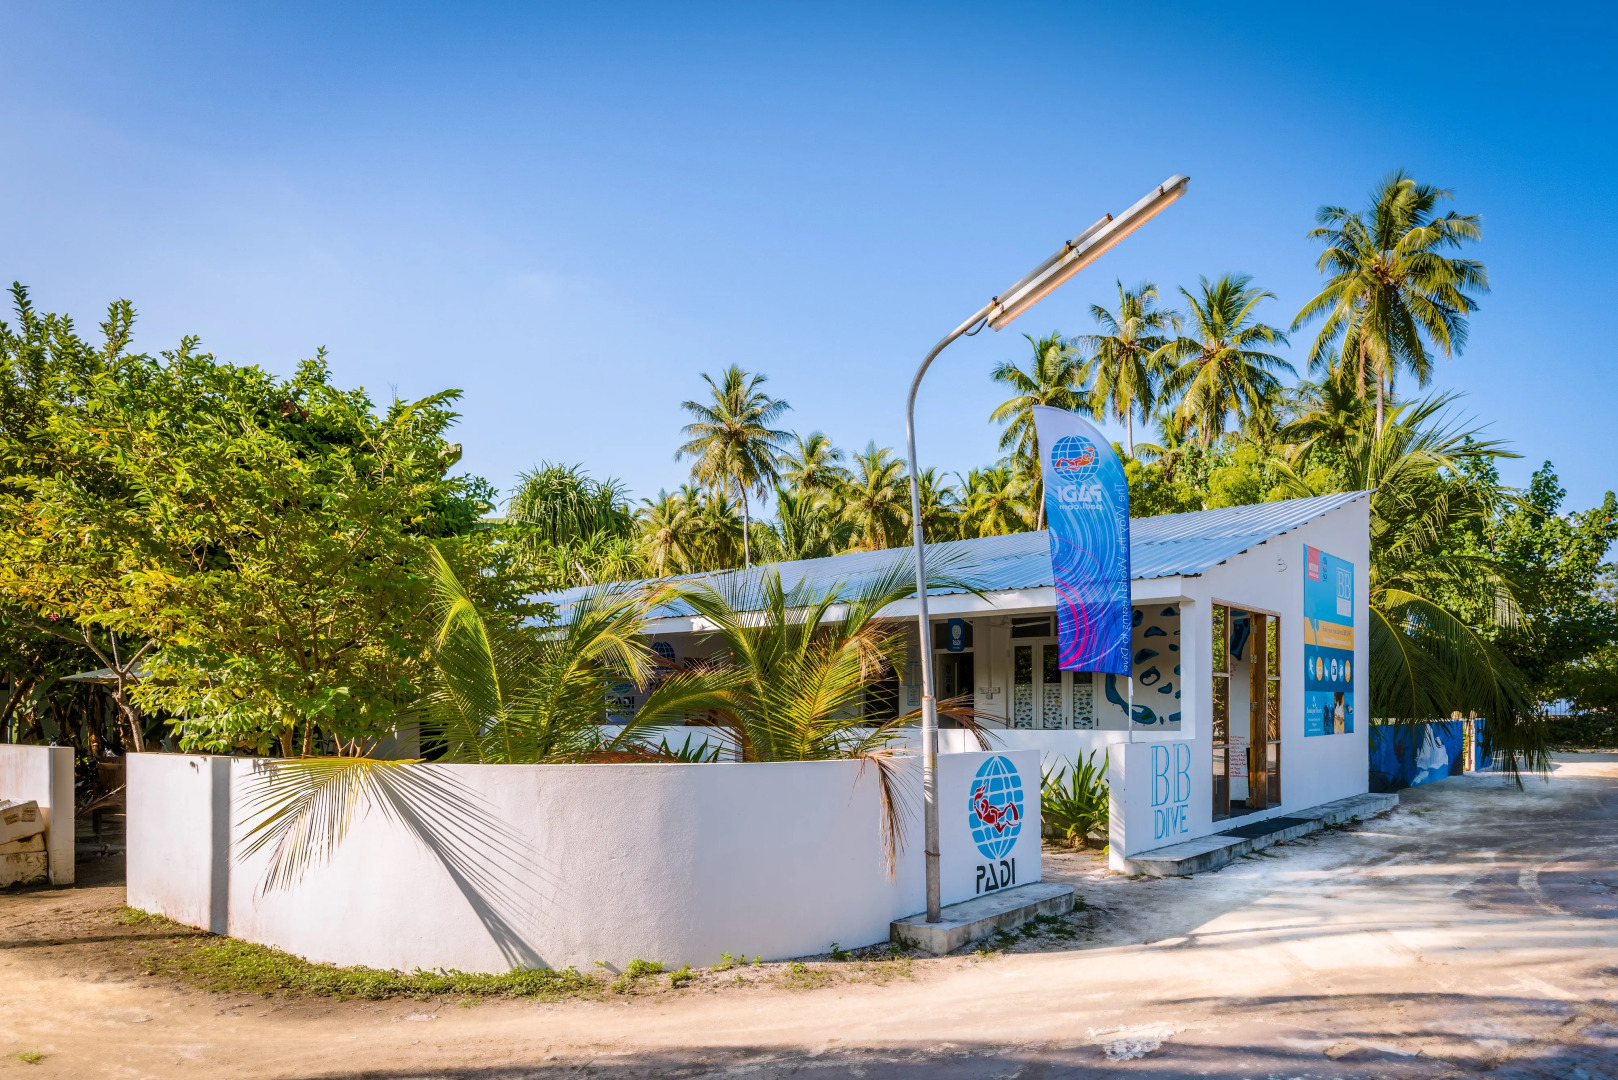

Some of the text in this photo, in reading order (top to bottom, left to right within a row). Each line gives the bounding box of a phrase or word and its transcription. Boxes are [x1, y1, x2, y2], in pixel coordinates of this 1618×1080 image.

[1151, 743, 1191, 807] BB
[1154, 804, 1189, 840] DIVE
[976, 857, 1016, 894] PADI
